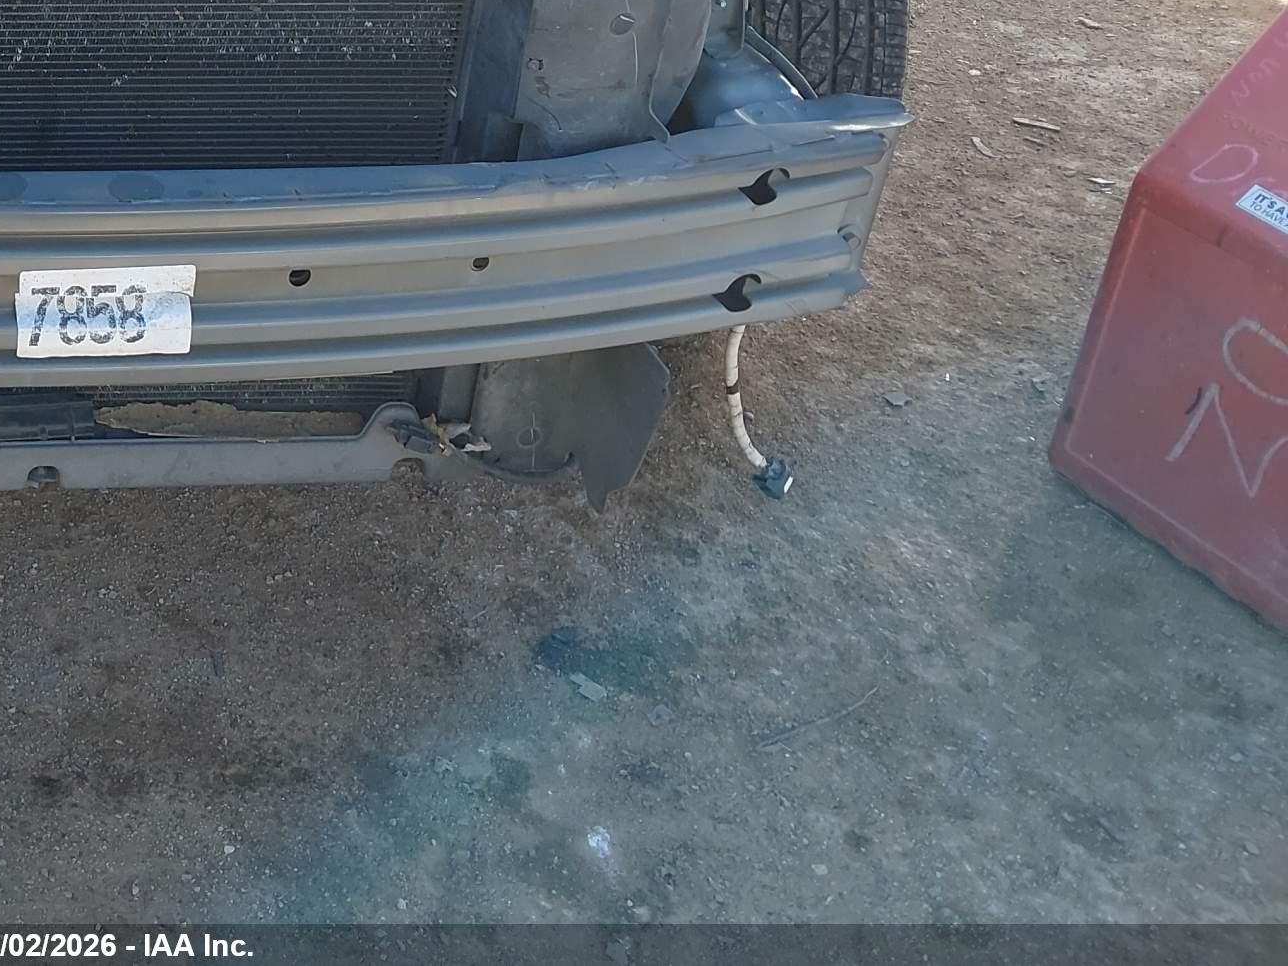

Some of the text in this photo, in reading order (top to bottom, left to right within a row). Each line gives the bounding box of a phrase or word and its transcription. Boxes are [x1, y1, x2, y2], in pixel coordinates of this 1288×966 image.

[1250, 200, 1263, 211] TO
[1255, 194, 1277, 209] IT'S
[28, 284, 147, 346] 7858
